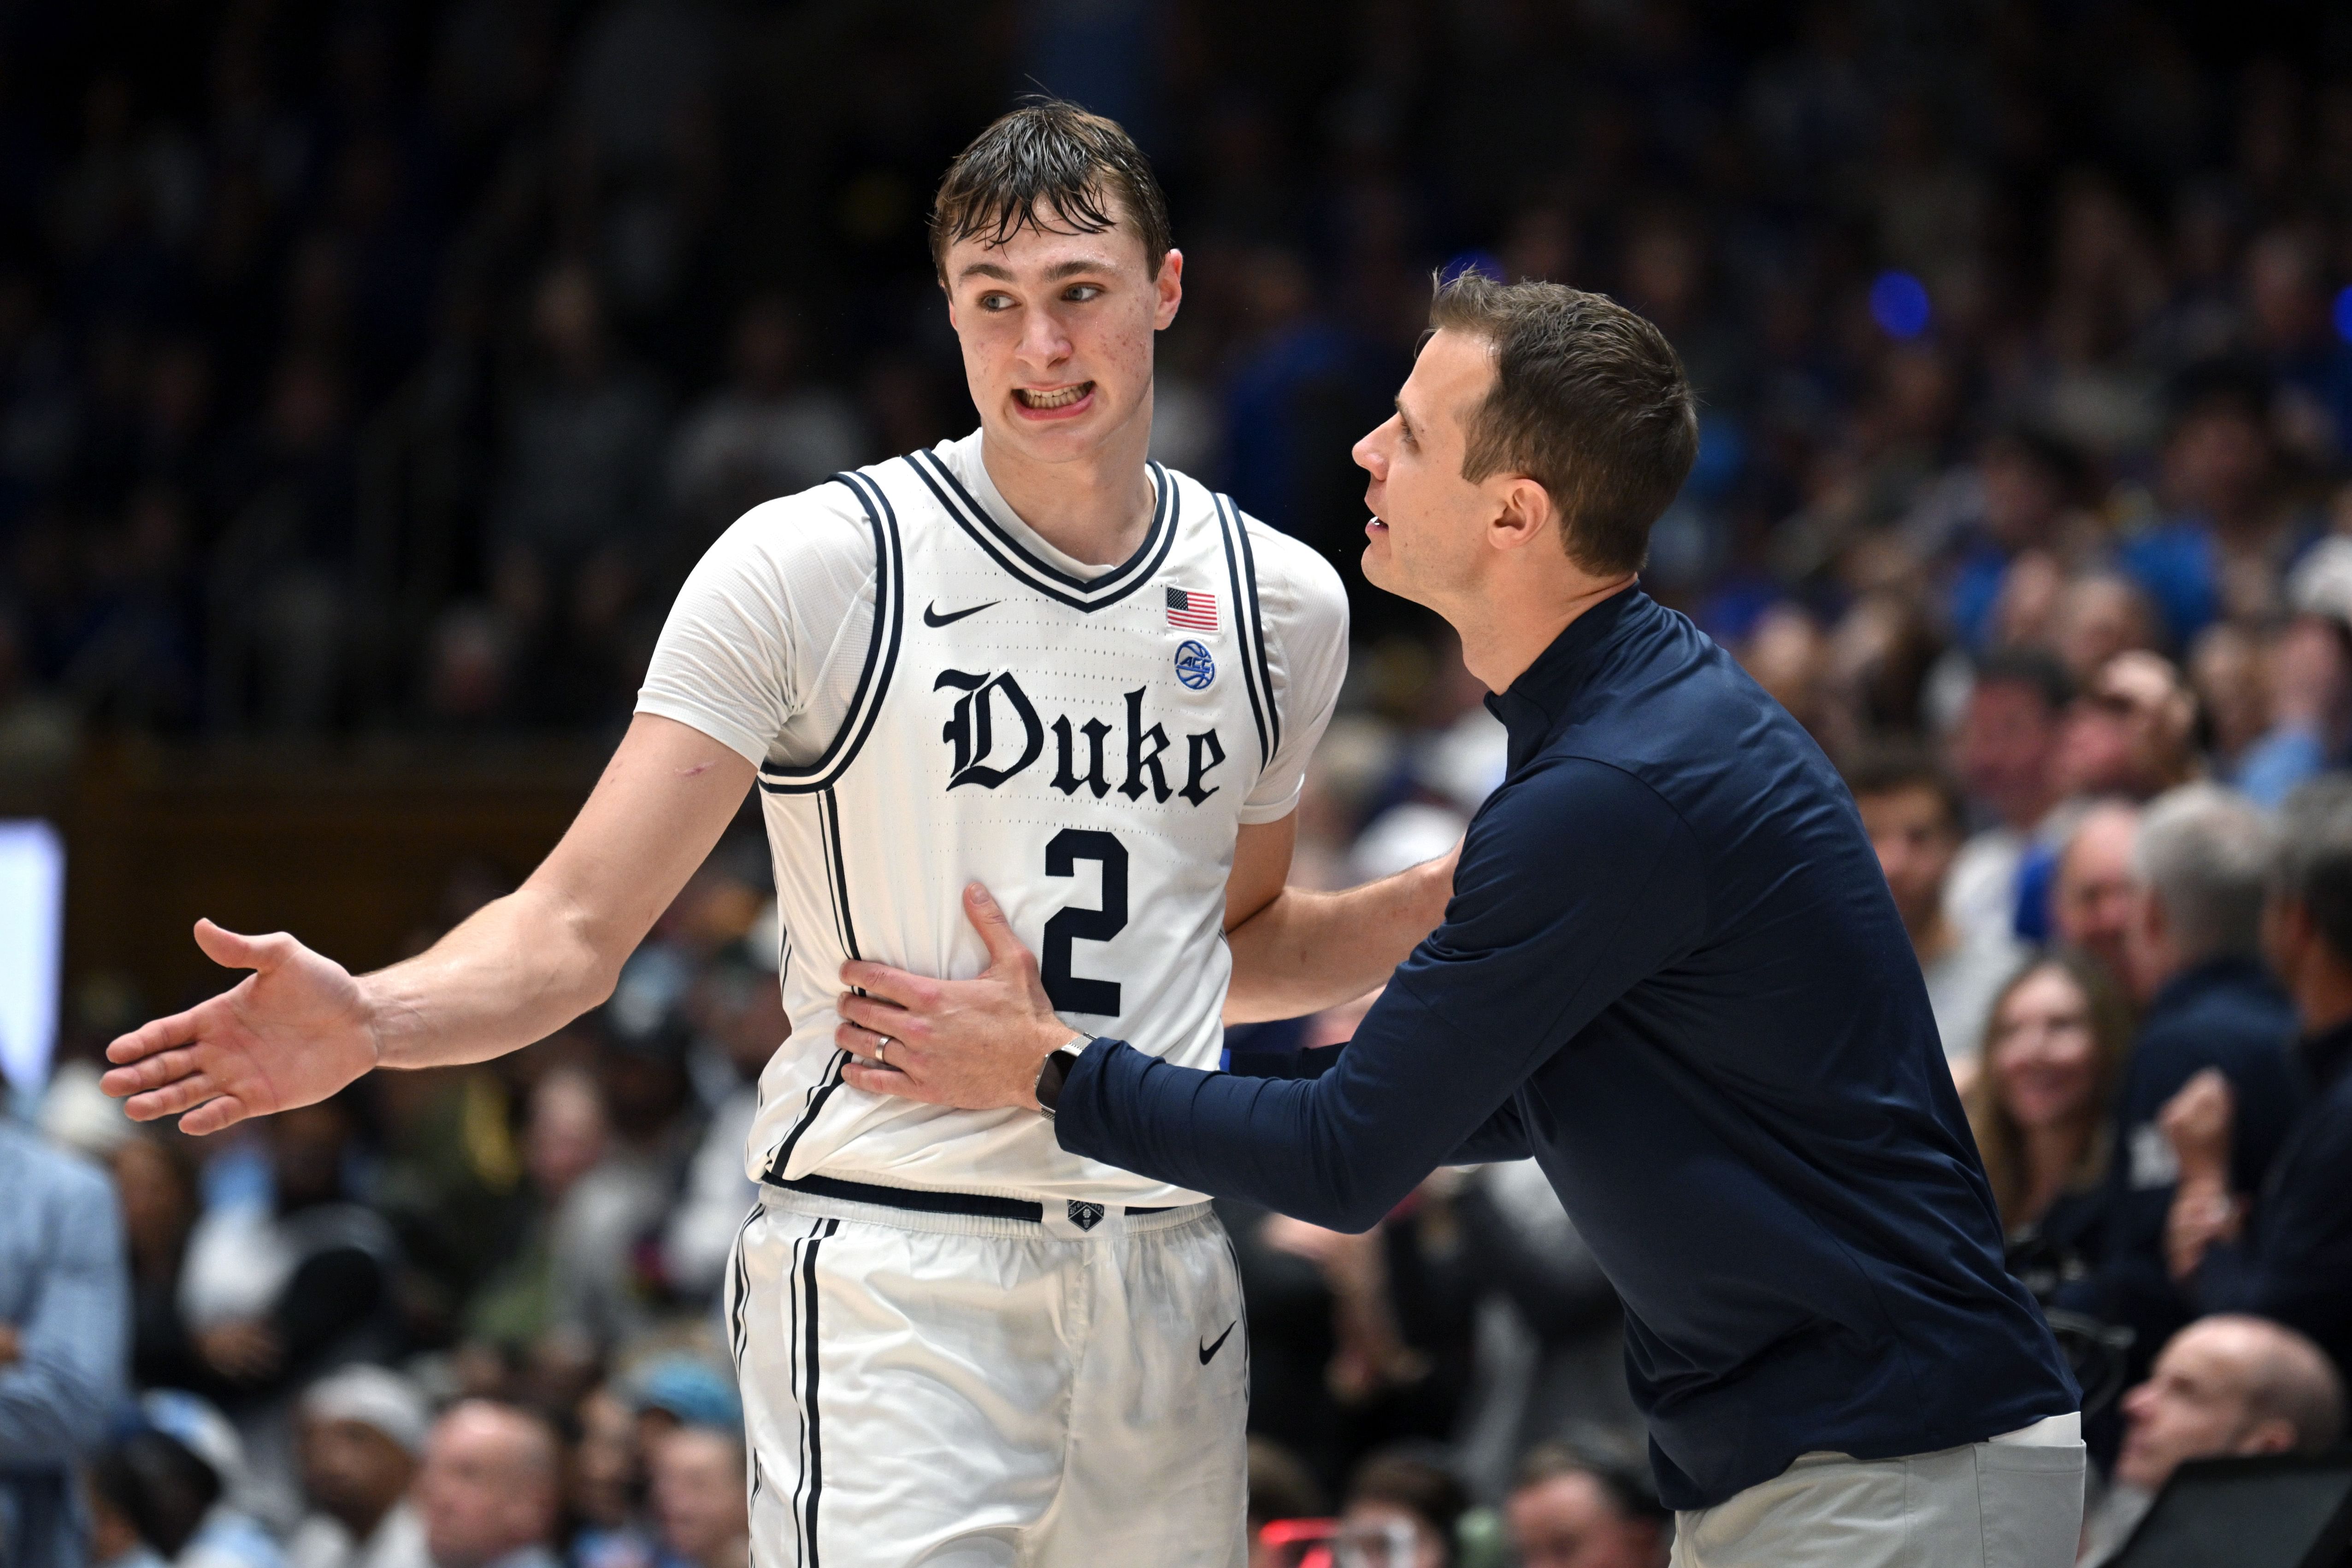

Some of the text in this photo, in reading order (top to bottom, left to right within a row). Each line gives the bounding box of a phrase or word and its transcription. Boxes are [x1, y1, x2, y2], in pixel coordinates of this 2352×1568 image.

[1179, 656, 1212, 671] ACC
[933, 669, 1226, 808] Duke
[1040, 828, 1129, 1017] 2
